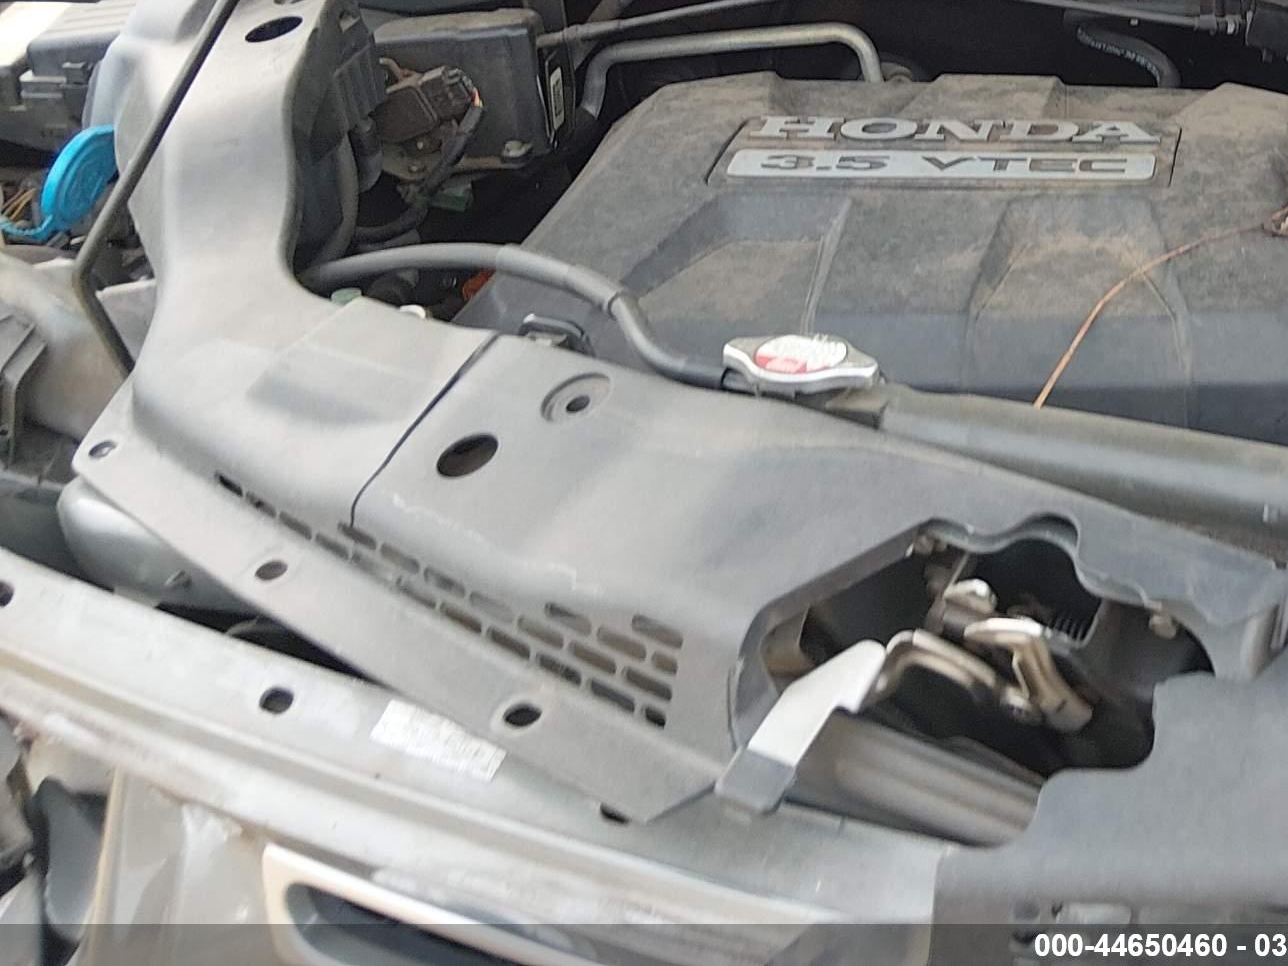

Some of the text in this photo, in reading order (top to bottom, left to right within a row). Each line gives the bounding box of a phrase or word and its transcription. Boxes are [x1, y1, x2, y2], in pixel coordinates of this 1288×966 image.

[750, 115, 1163, 144] HONDA
[760, 154, 1128, 174] 3.5 VTEC
